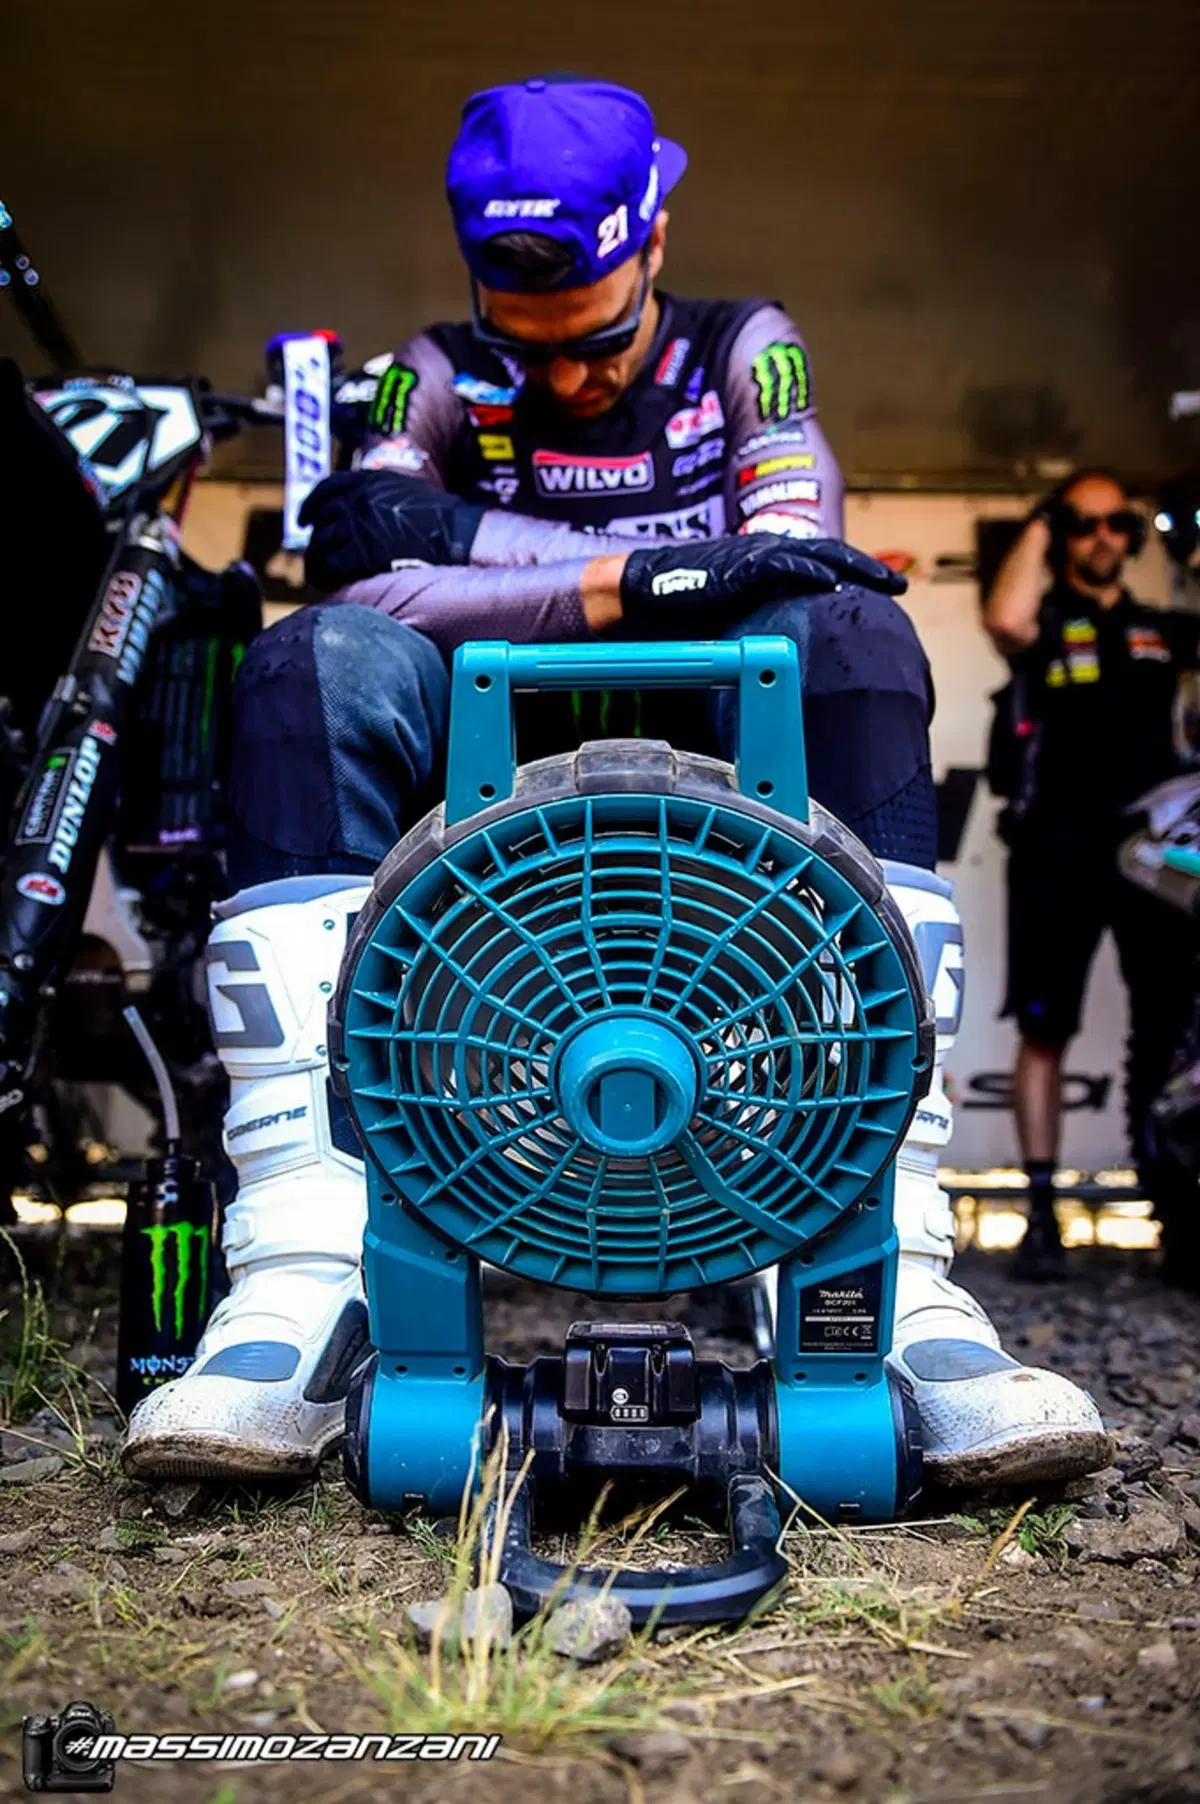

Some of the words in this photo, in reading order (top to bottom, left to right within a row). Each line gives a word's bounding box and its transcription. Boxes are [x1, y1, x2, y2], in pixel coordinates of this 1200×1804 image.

[597, 204, 629, 259] 21
[539, 463, 649, 492] WILVO
[48, 734, 102, 874] DUNLOP
